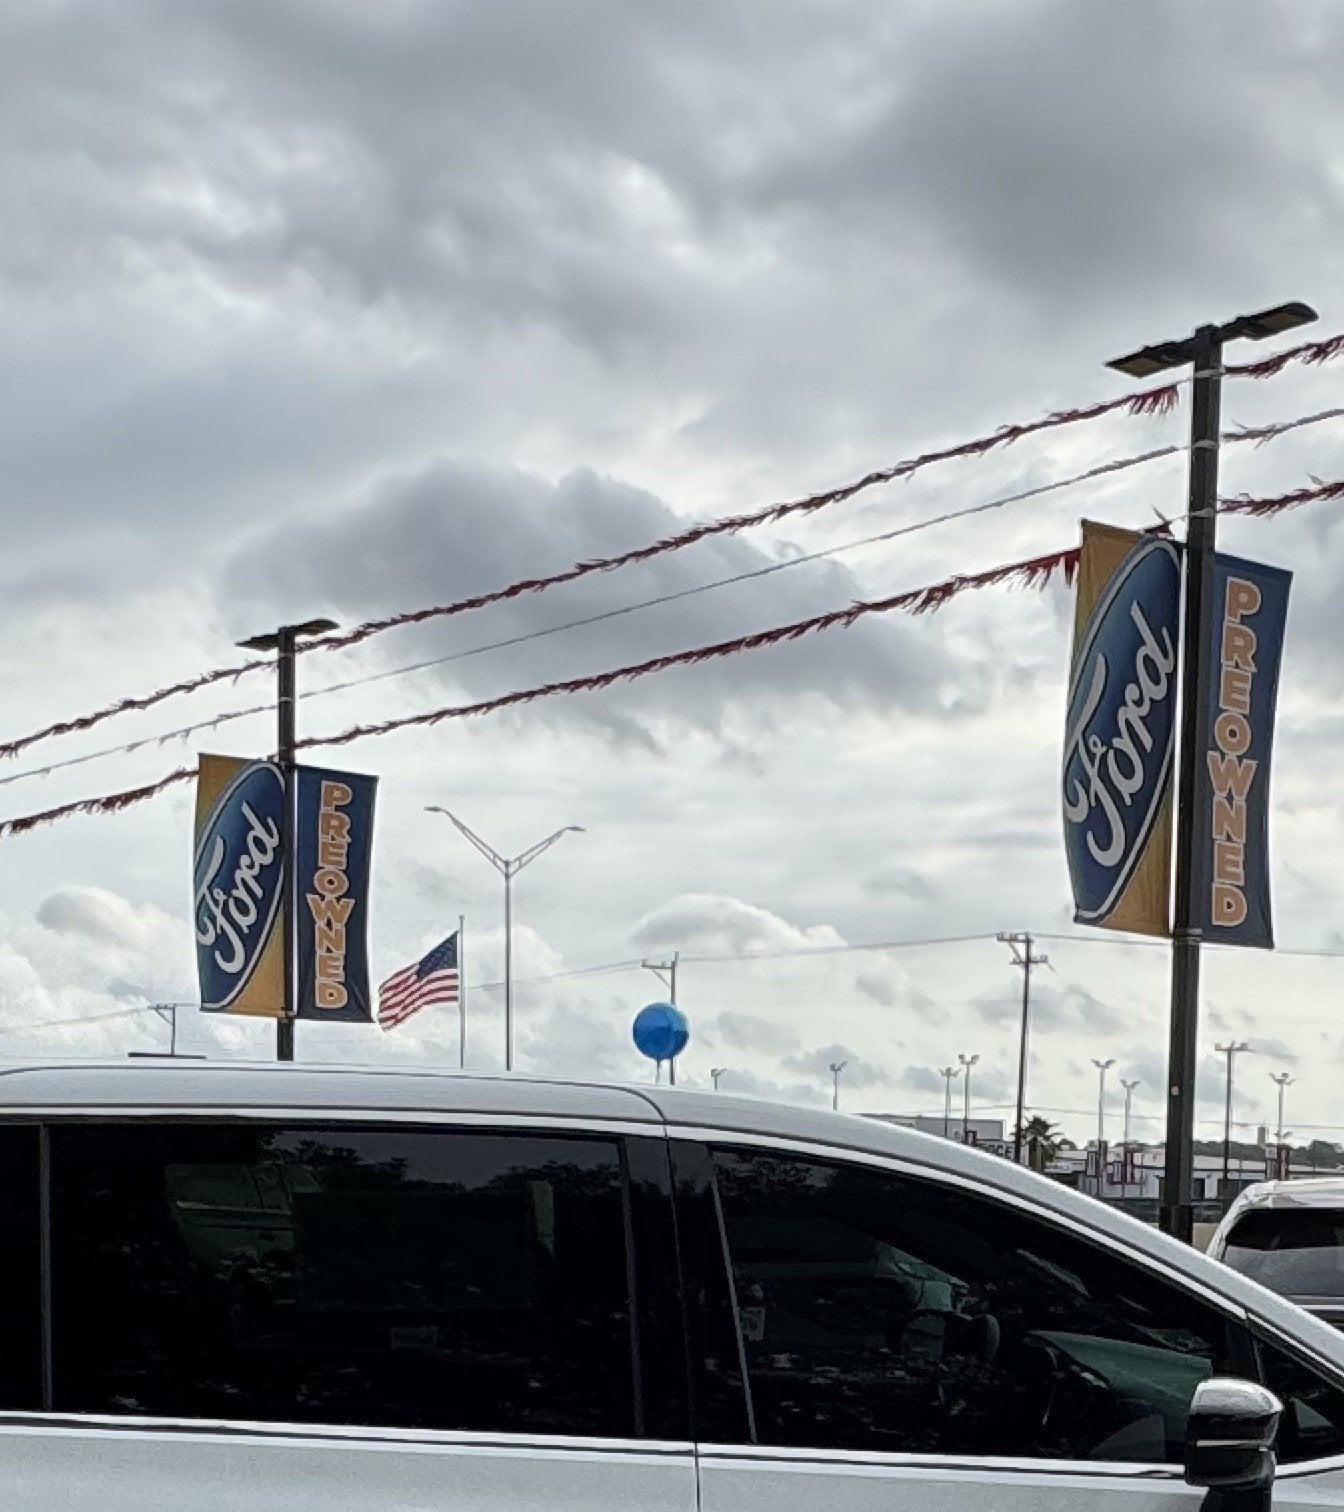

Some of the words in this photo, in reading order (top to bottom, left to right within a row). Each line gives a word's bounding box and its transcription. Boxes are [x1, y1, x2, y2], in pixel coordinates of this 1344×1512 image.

[1063, 600, 1175, 867] Ford
[1206, 577, 1263, 927] PREOWNED
[197, 800, 280, 974] Ford
[306, 780, 356, 1009] PREOWNED
